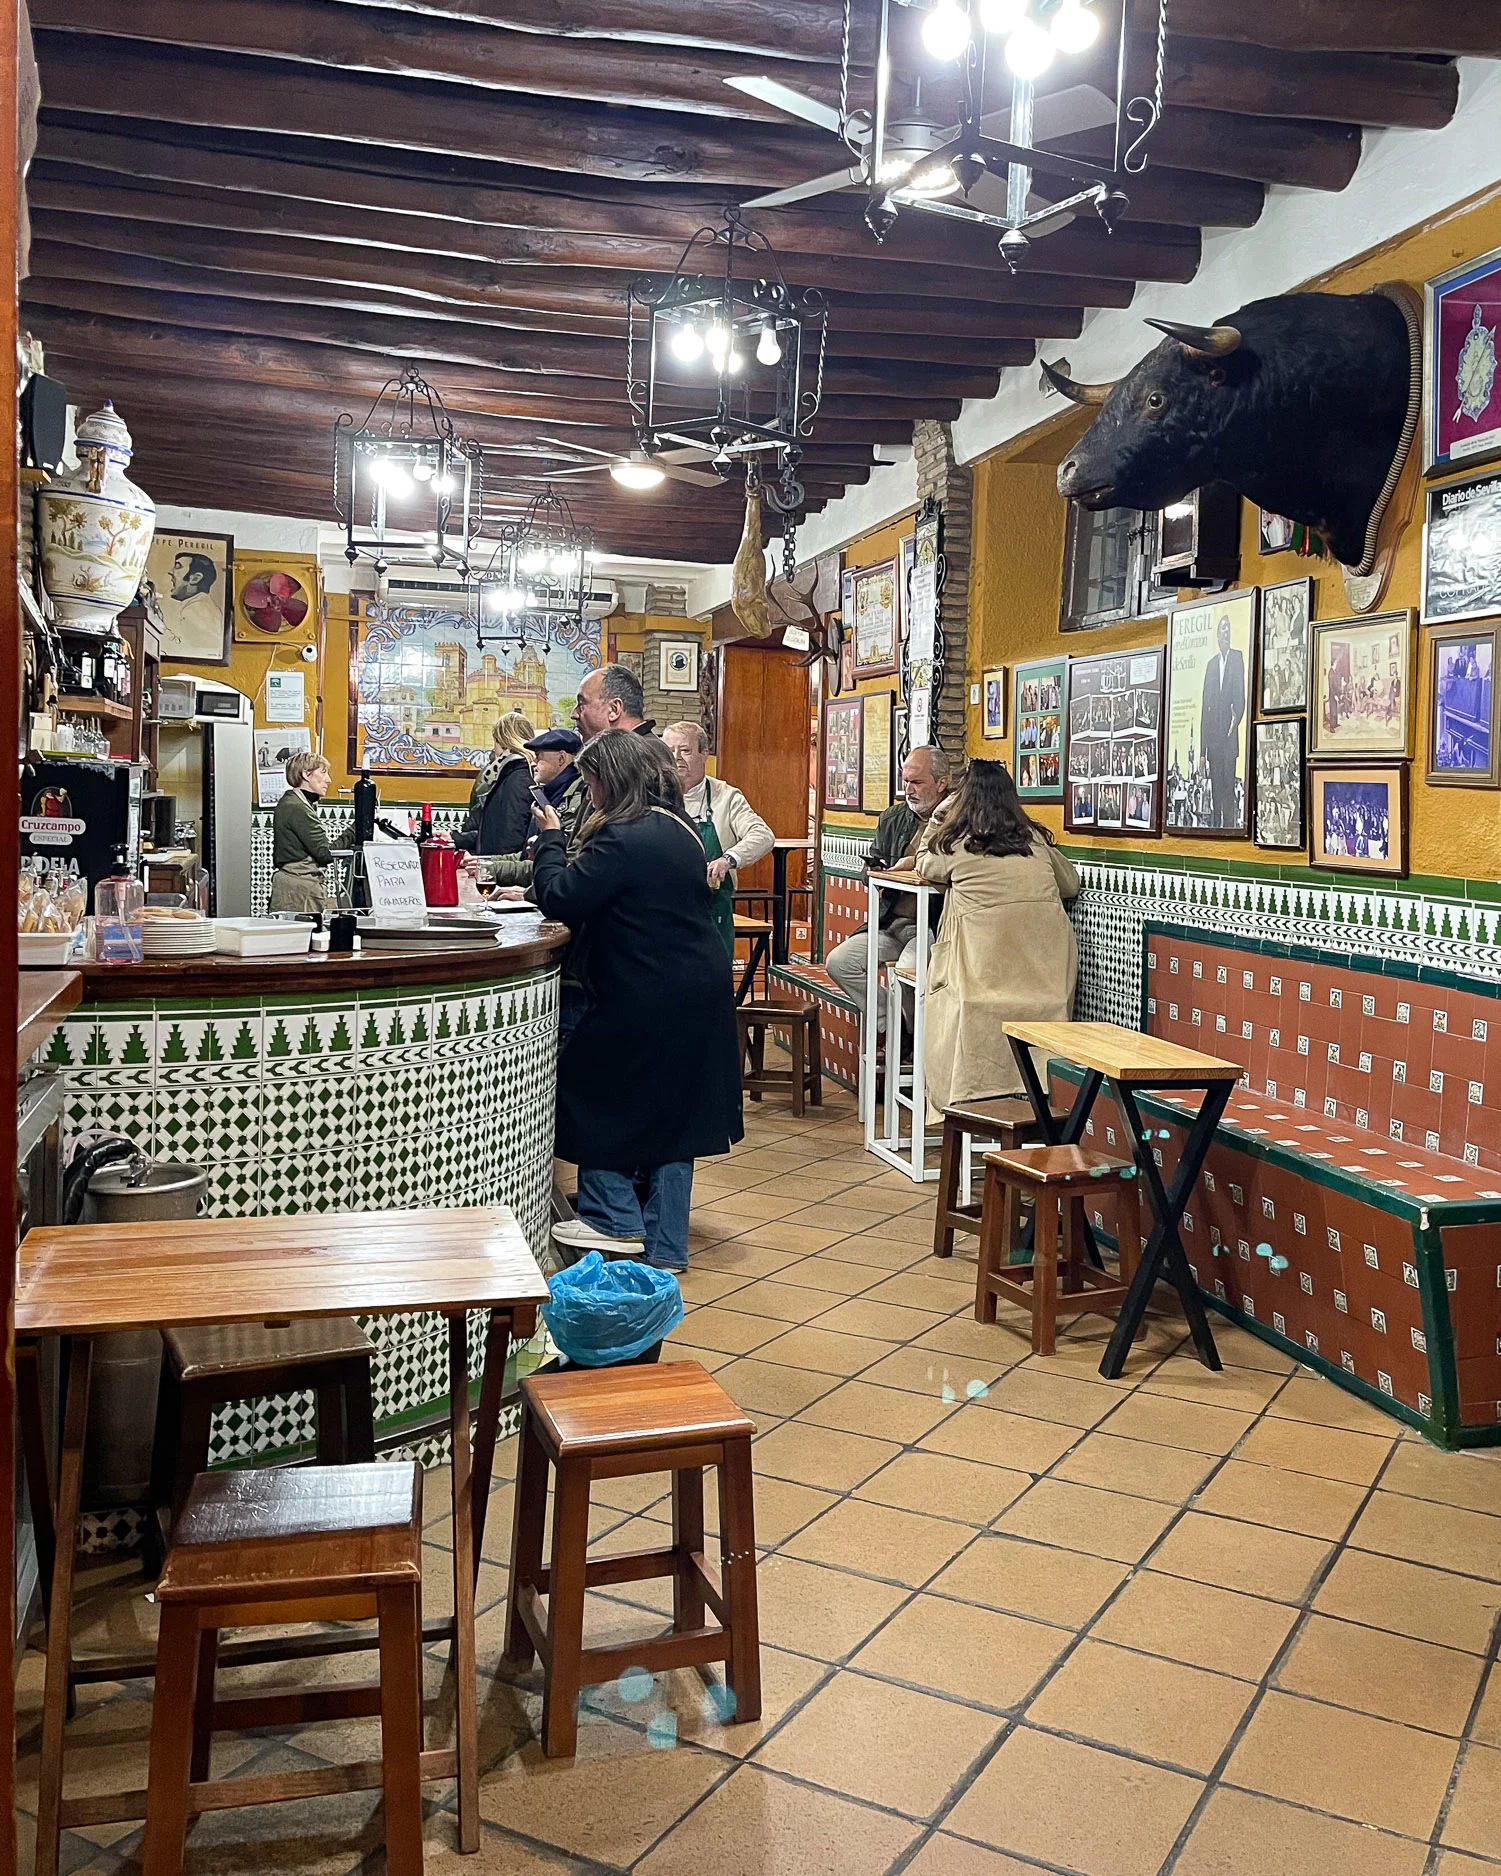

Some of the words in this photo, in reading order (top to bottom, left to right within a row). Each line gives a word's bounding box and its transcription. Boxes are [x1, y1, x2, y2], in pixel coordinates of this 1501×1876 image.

[1442, 488, 1465, 506] Diario
[1465, 486, 1476, 500] de
[178, 539, 214, 550] PEREGIL
[1174, 613, 1212, 637] PEREGIL
[21, 820, 81, 833] Cruzcampo
[33, 835, 68, 843] ESPECIAL
[376, 874, 406, 888] PARA
